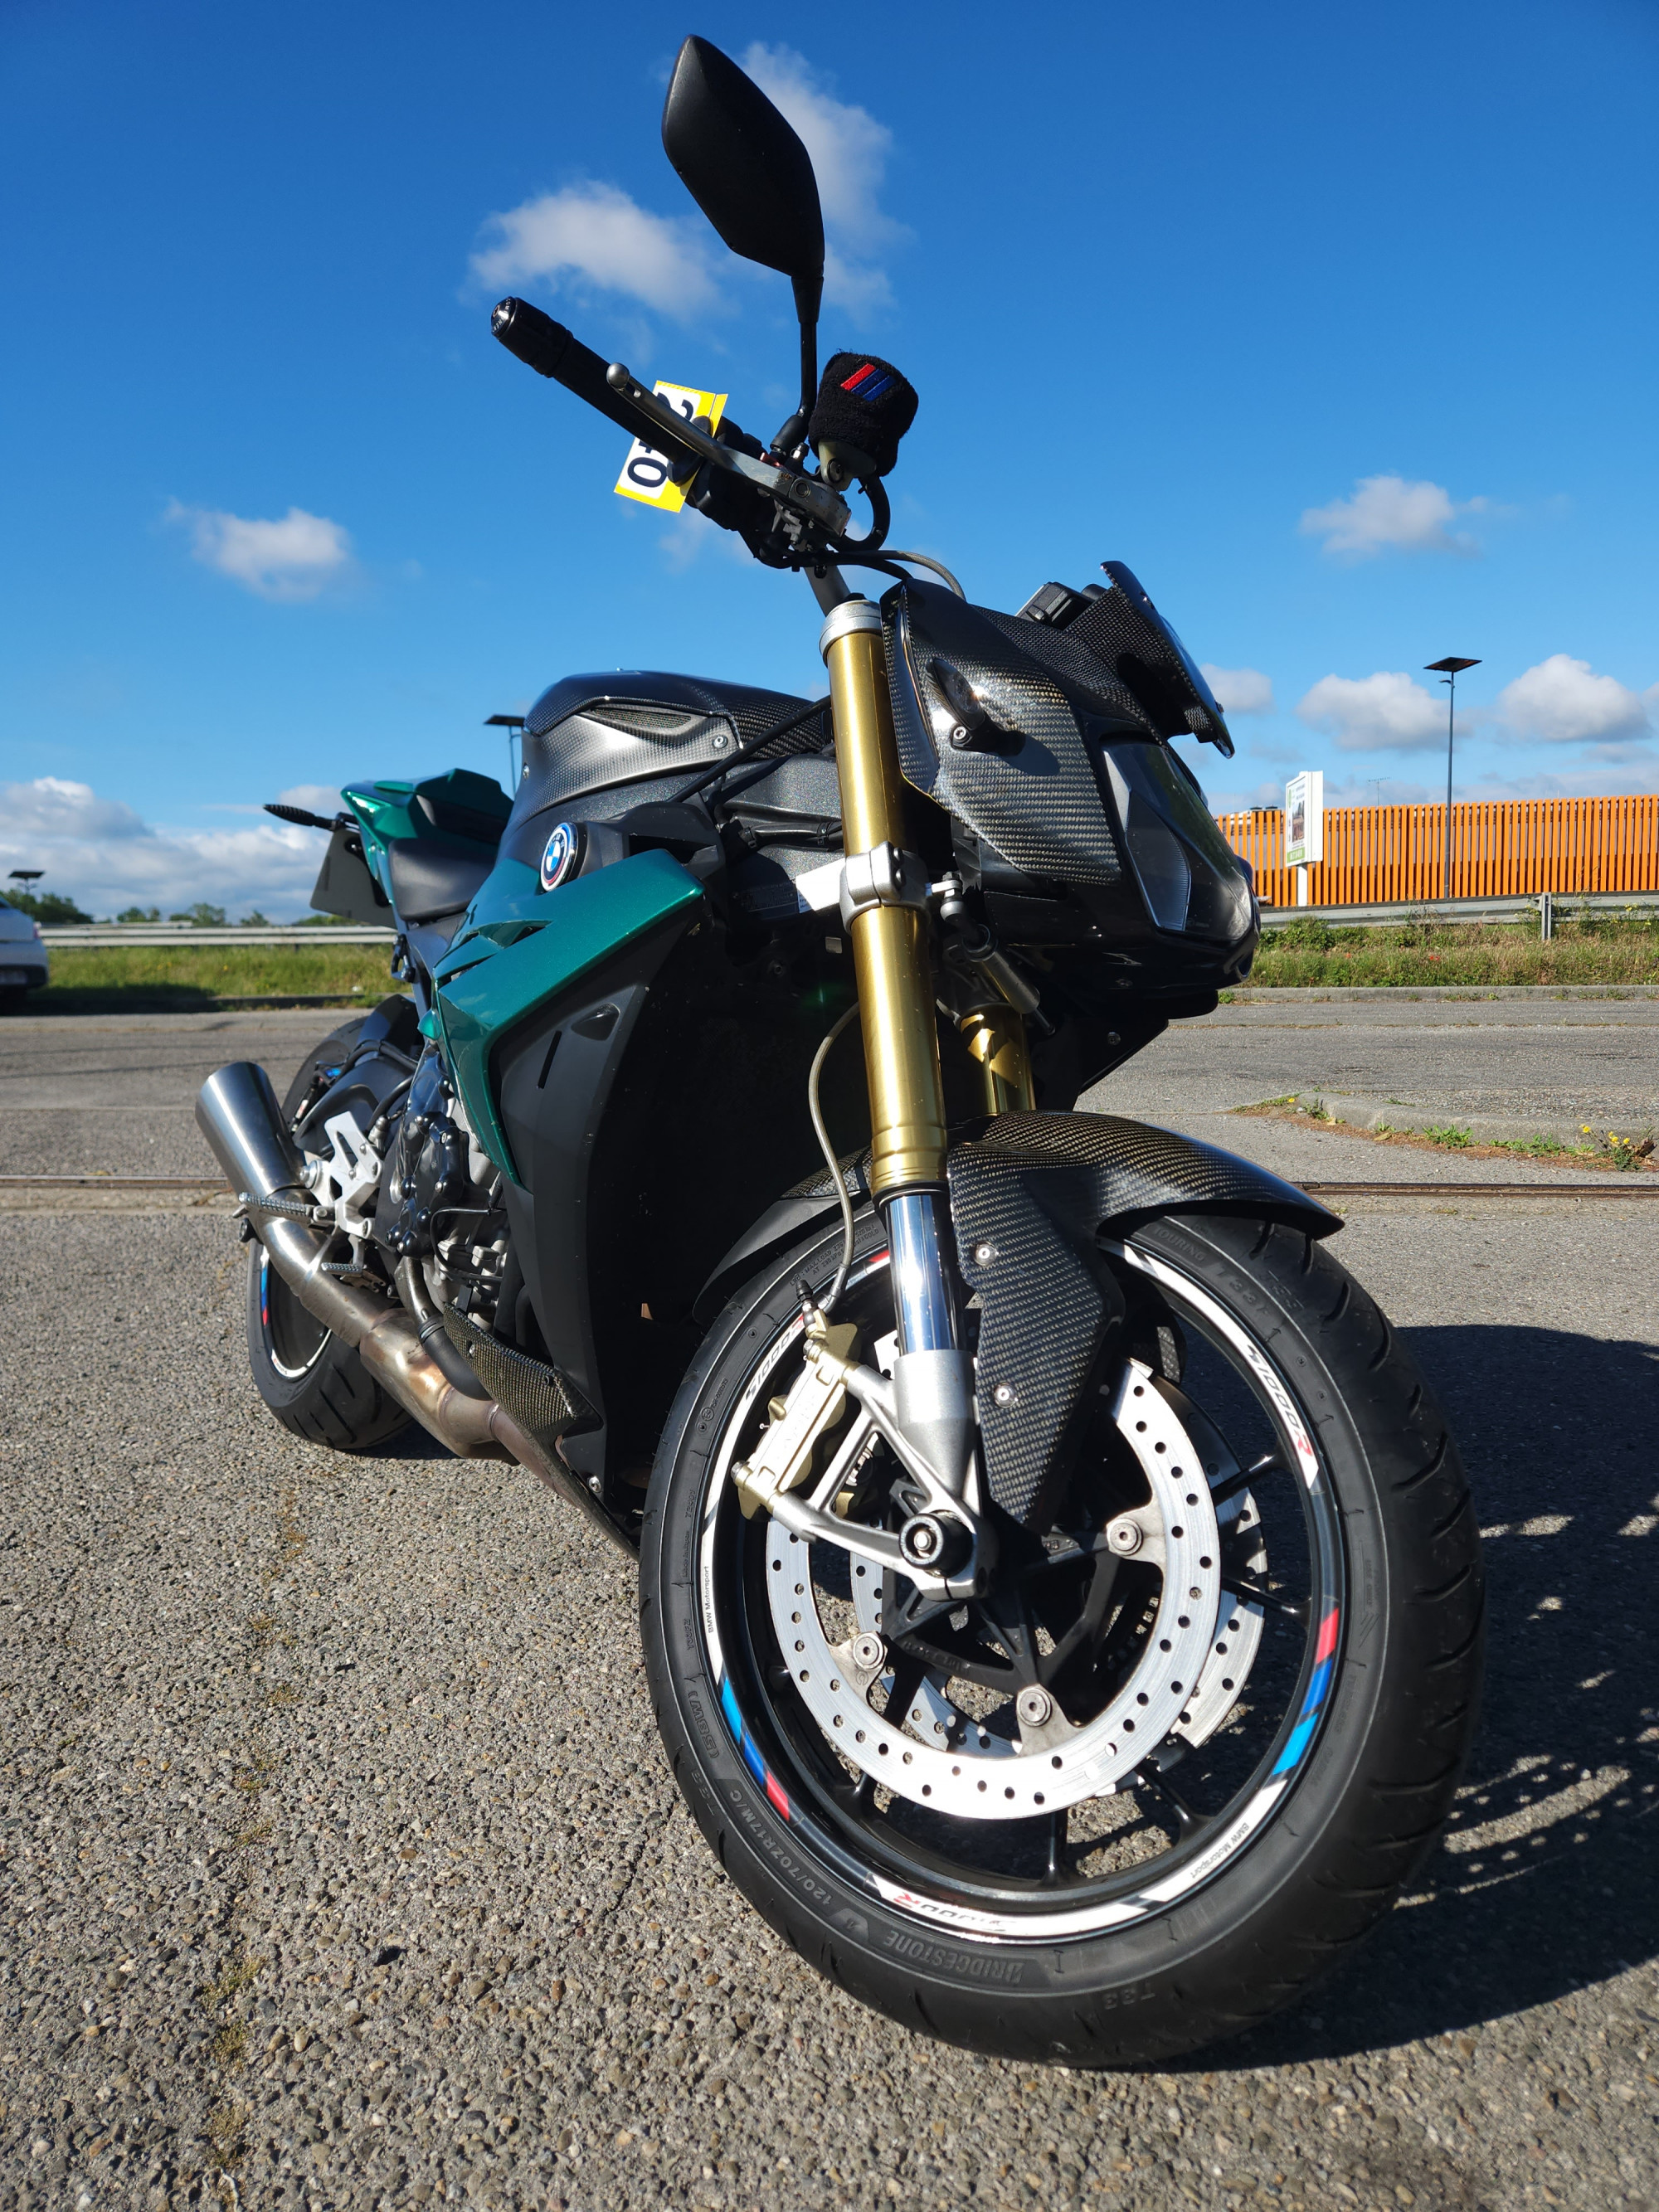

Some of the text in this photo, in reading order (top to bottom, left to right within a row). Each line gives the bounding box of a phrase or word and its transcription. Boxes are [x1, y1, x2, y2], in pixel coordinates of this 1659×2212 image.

[1247, 1344, 1314, 1456] S1000R
[704, 1612, 714, 1632] BMW
[1189, 1821, 1250, 1879] BMW Motorsport
